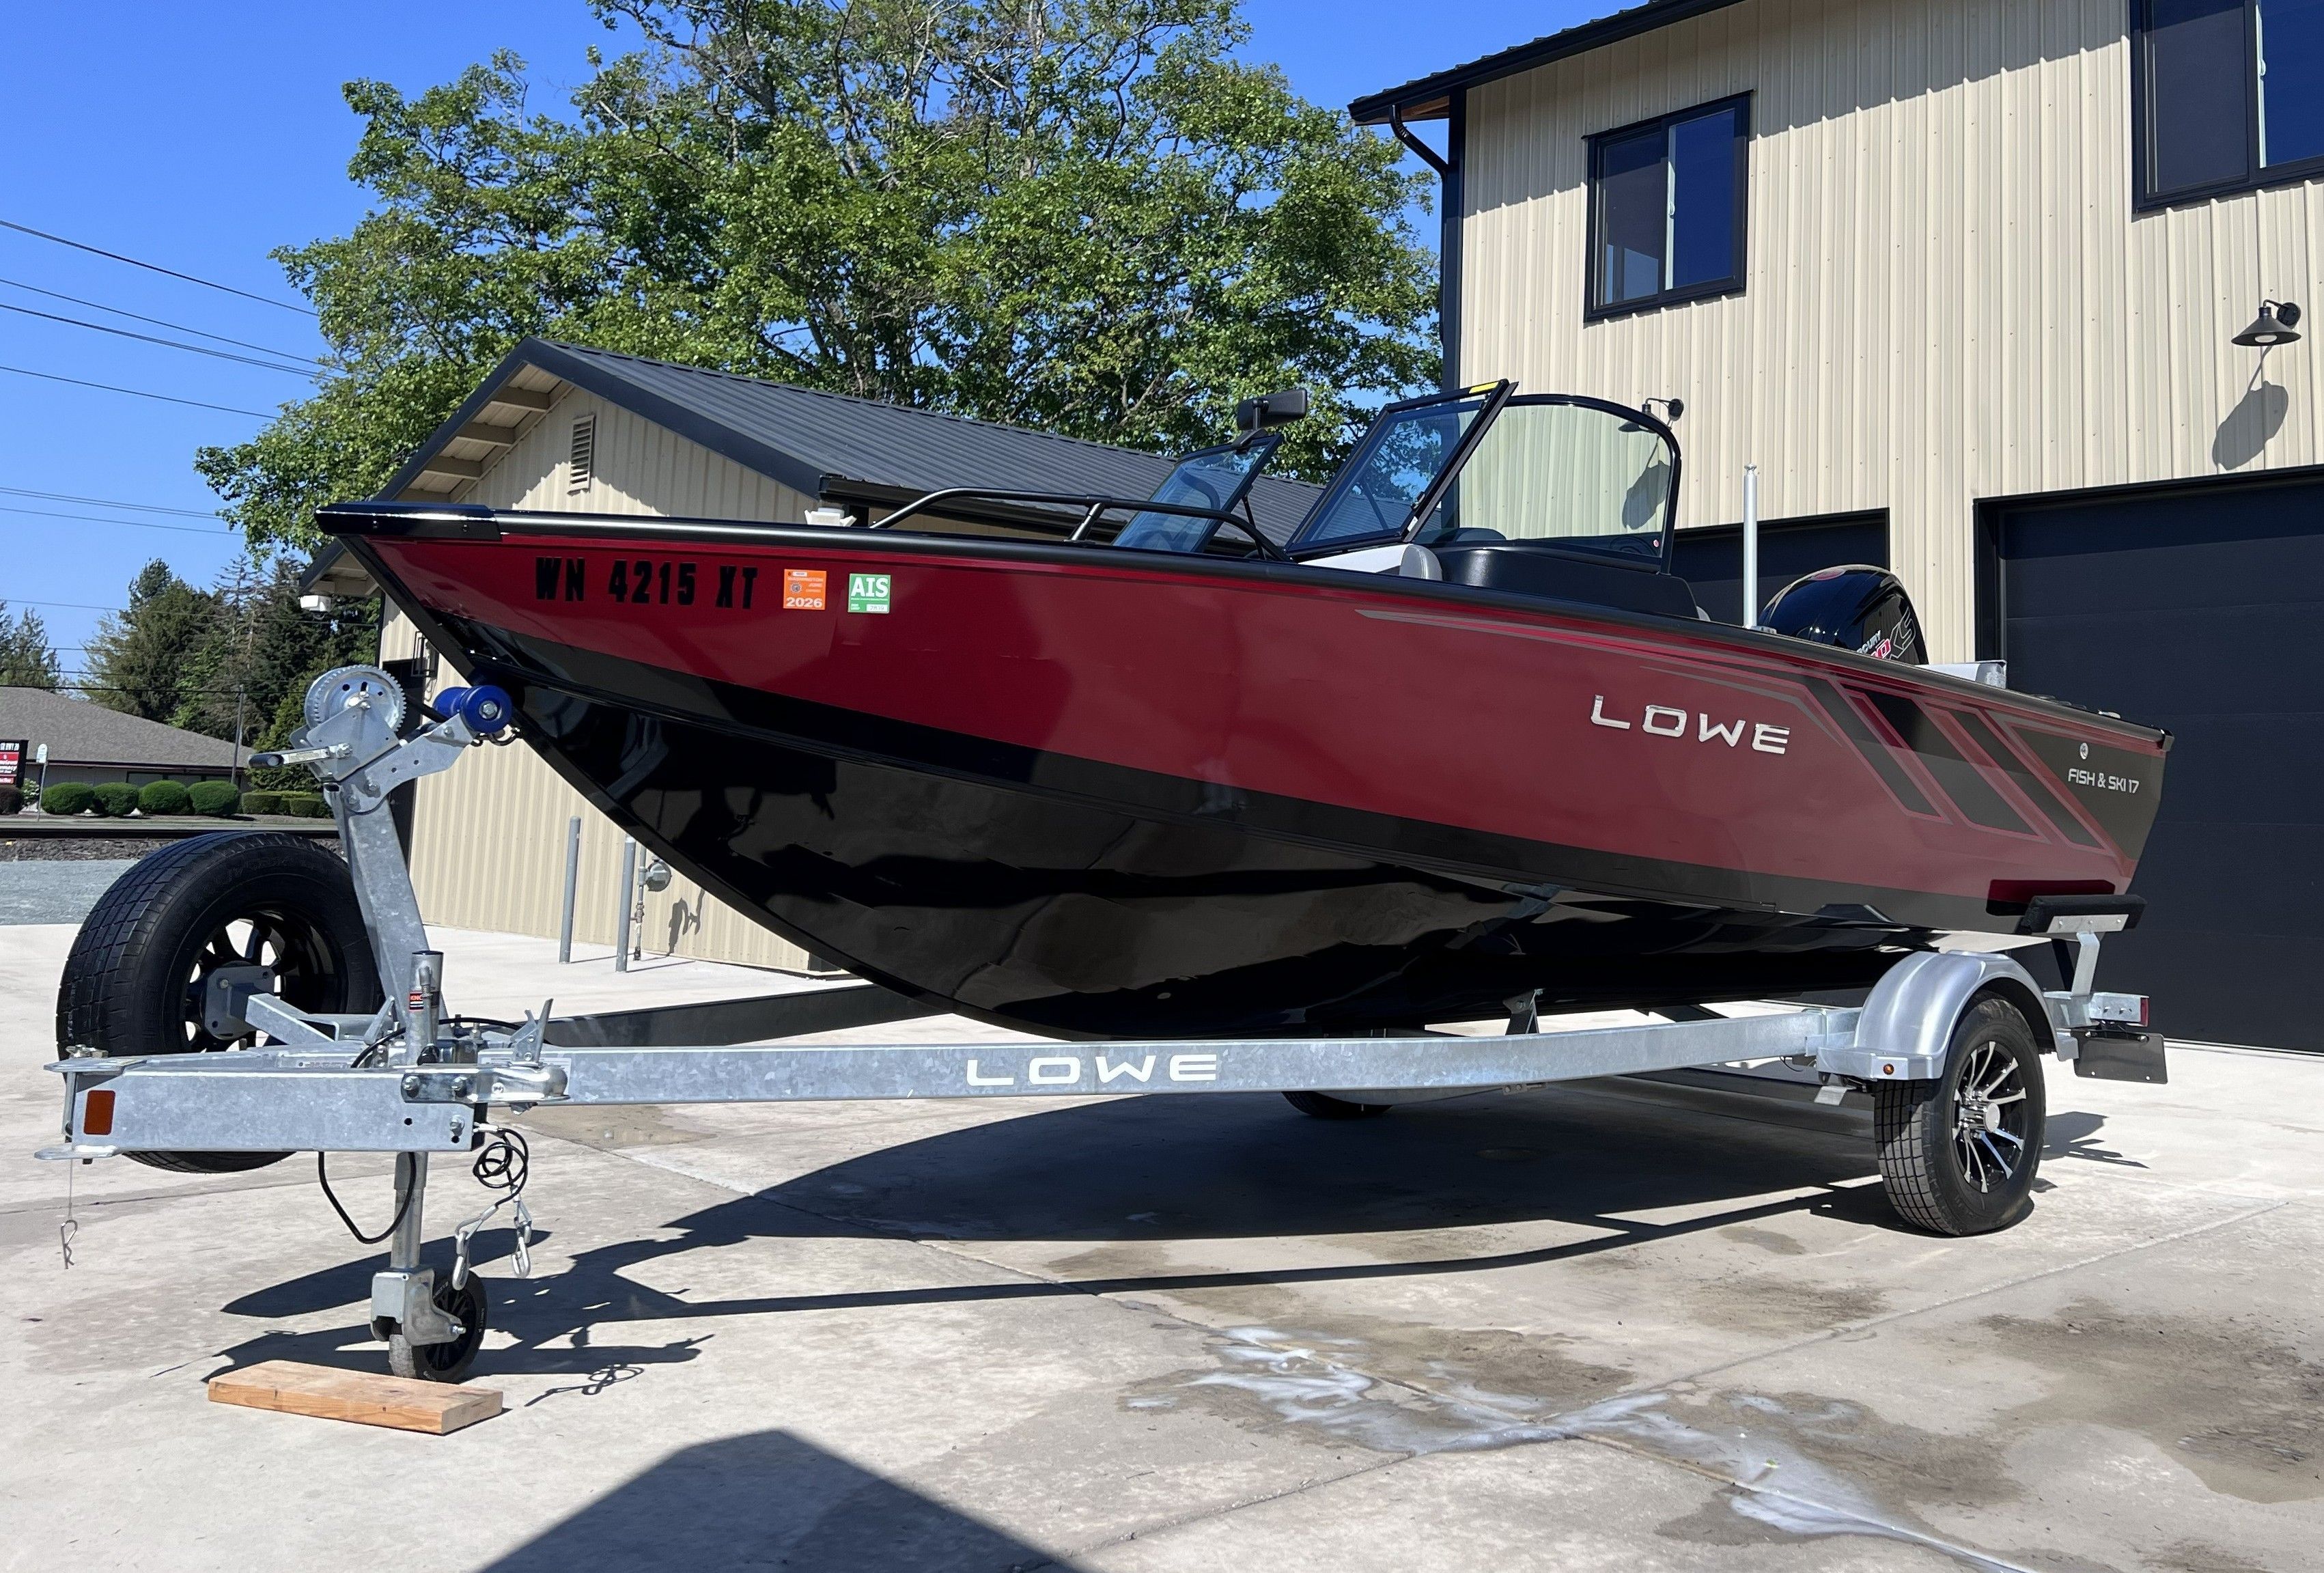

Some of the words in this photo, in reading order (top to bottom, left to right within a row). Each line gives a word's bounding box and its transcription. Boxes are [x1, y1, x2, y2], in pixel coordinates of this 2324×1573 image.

[535, 556, 586, 602] WN
[608, 559, 697, 604] 4215
[715, 565, 758, 609] XT
[850, 576, 888, 598] AIS
[785, 596, 823, 609] 2026
[1591, 694, 1791, 755] LOWE
[2068, 768, 2096, 787] FISH
[2097, 772, 2106, 789] &
[2108, 775, 2127, 793] SKI
[2129, 779, 2140, 794] 17
[966, 1054, 1217, 1087] LOWE
